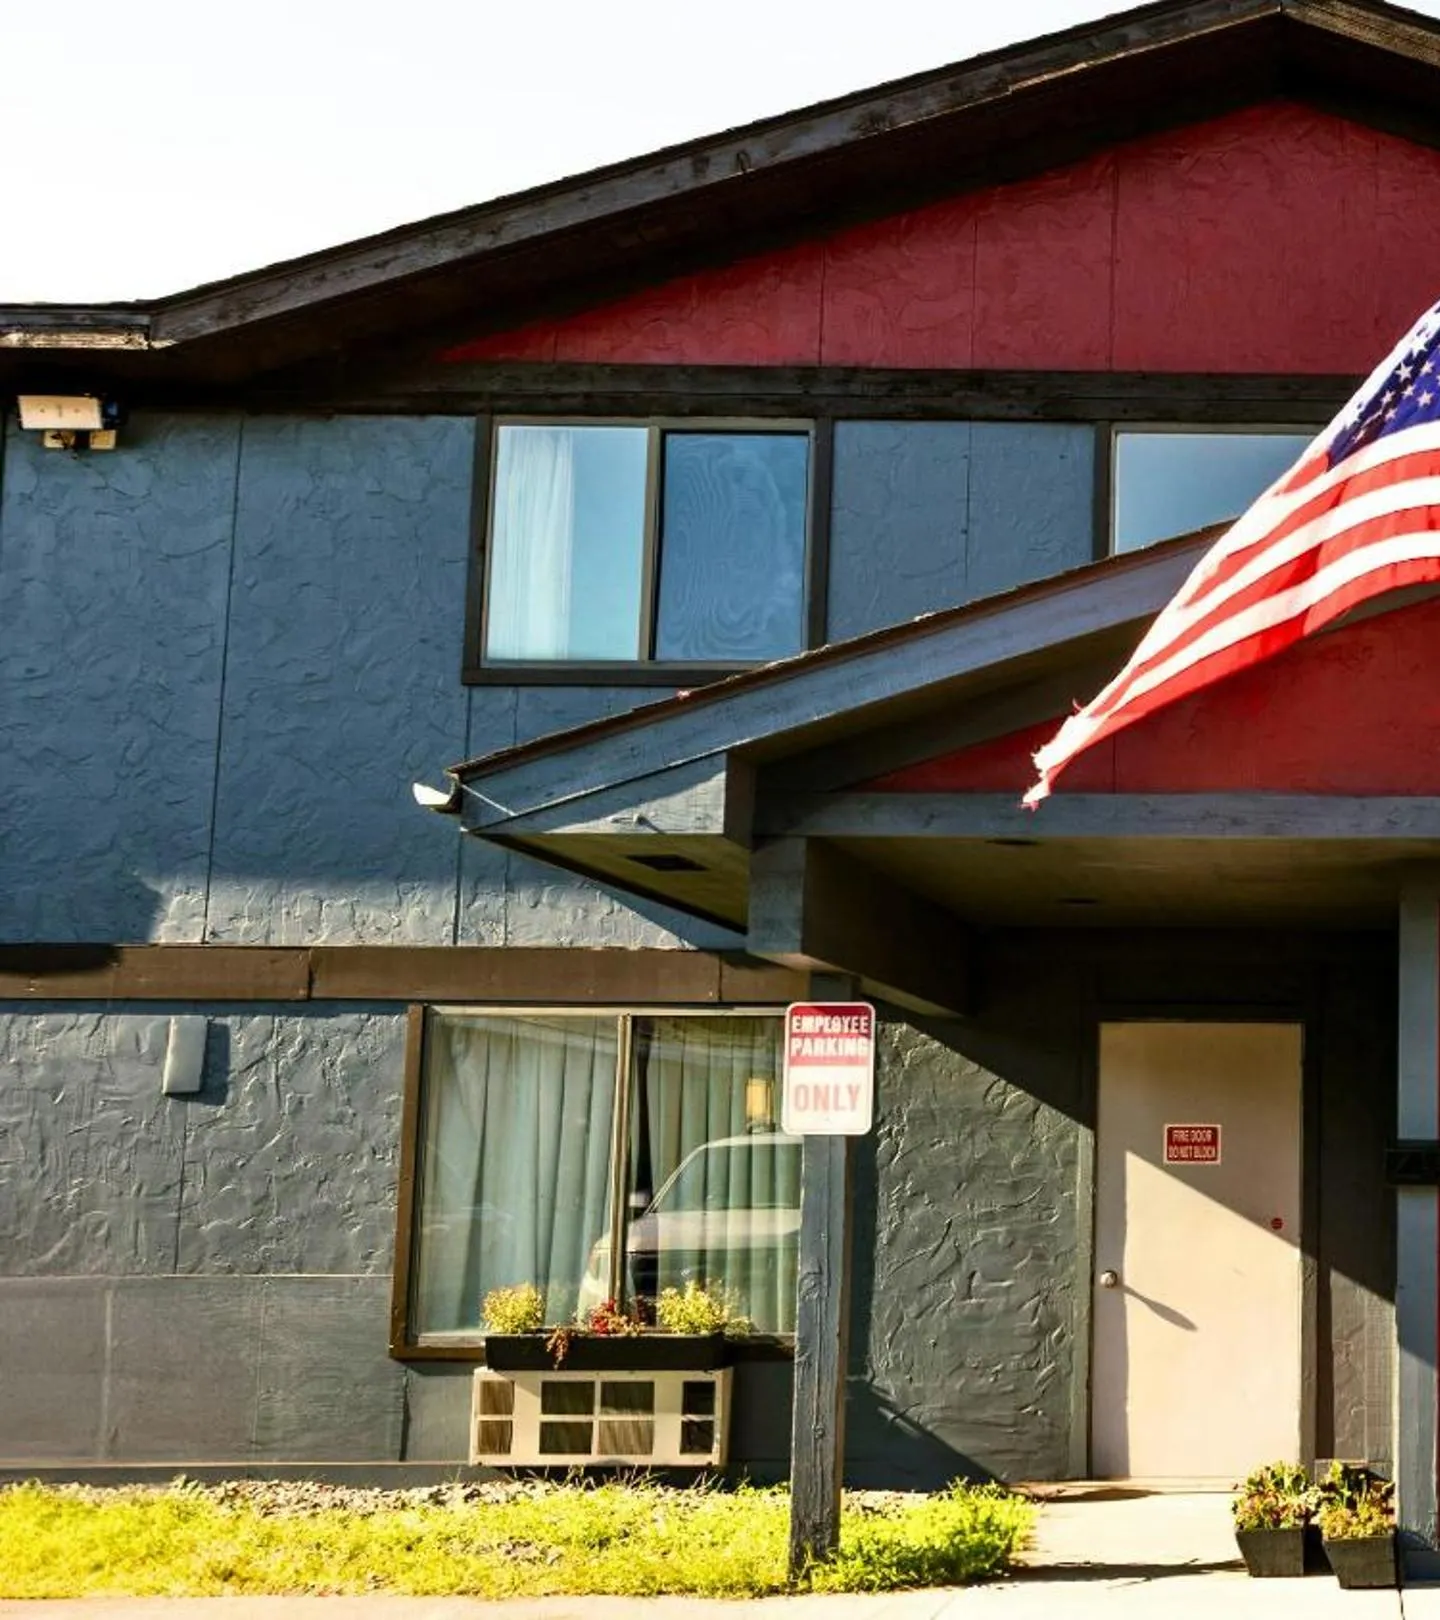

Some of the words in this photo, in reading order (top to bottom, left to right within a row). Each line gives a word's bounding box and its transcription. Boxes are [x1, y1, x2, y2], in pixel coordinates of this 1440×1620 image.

[792, 1015, 869, 1033] EMPLOYEE
[790, 1037, 870, 1057] PARKING
[794, 1083, 861, 1112] ONLY
[1172, 1129, 1189, 1142] FIRE
